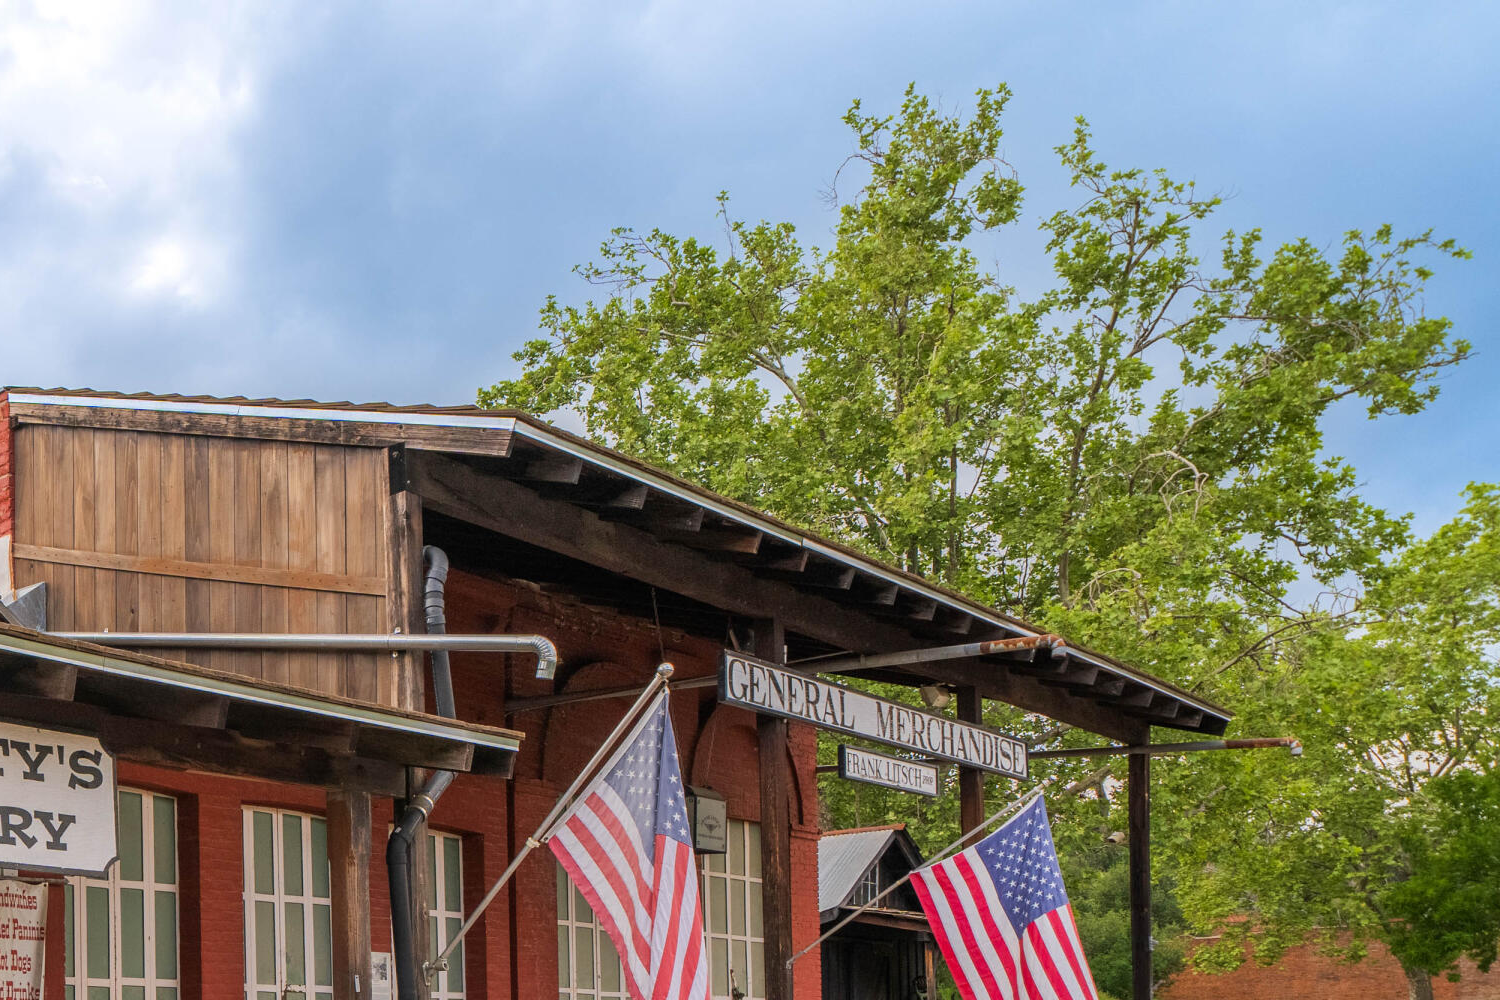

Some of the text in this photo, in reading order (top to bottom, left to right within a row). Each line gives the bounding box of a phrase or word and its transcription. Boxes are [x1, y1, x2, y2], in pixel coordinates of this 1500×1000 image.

[728, 658, 1026, 775] GENERAL MERCHANDISE
[847, 752, 883, 779] FRANK
[886, 762, 922, 787] LITSCH
